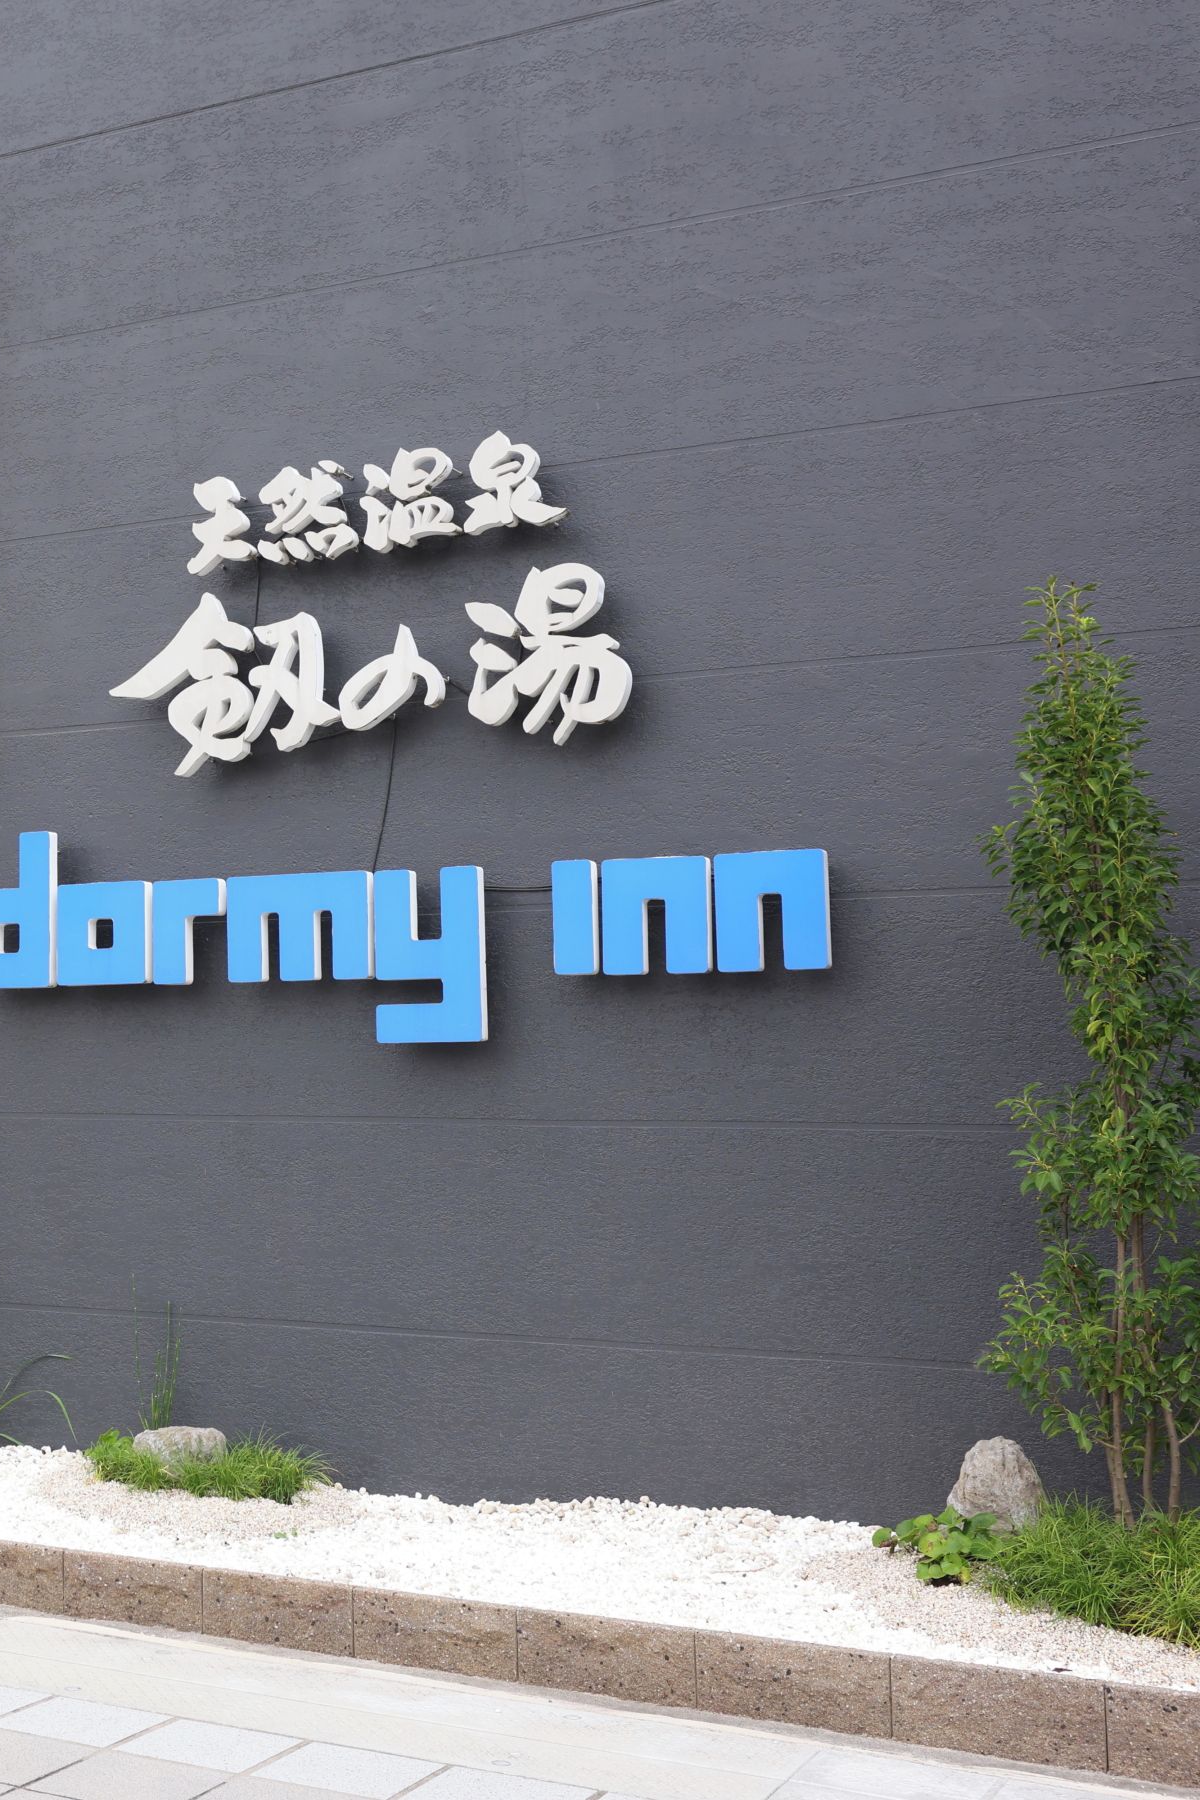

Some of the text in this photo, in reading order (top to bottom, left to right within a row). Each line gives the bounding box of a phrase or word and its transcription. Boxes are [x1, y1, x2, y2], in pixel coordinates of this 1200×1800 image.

[187, 430, 568, 576] 天然温泉
[550, 848, 833, 976] inn
